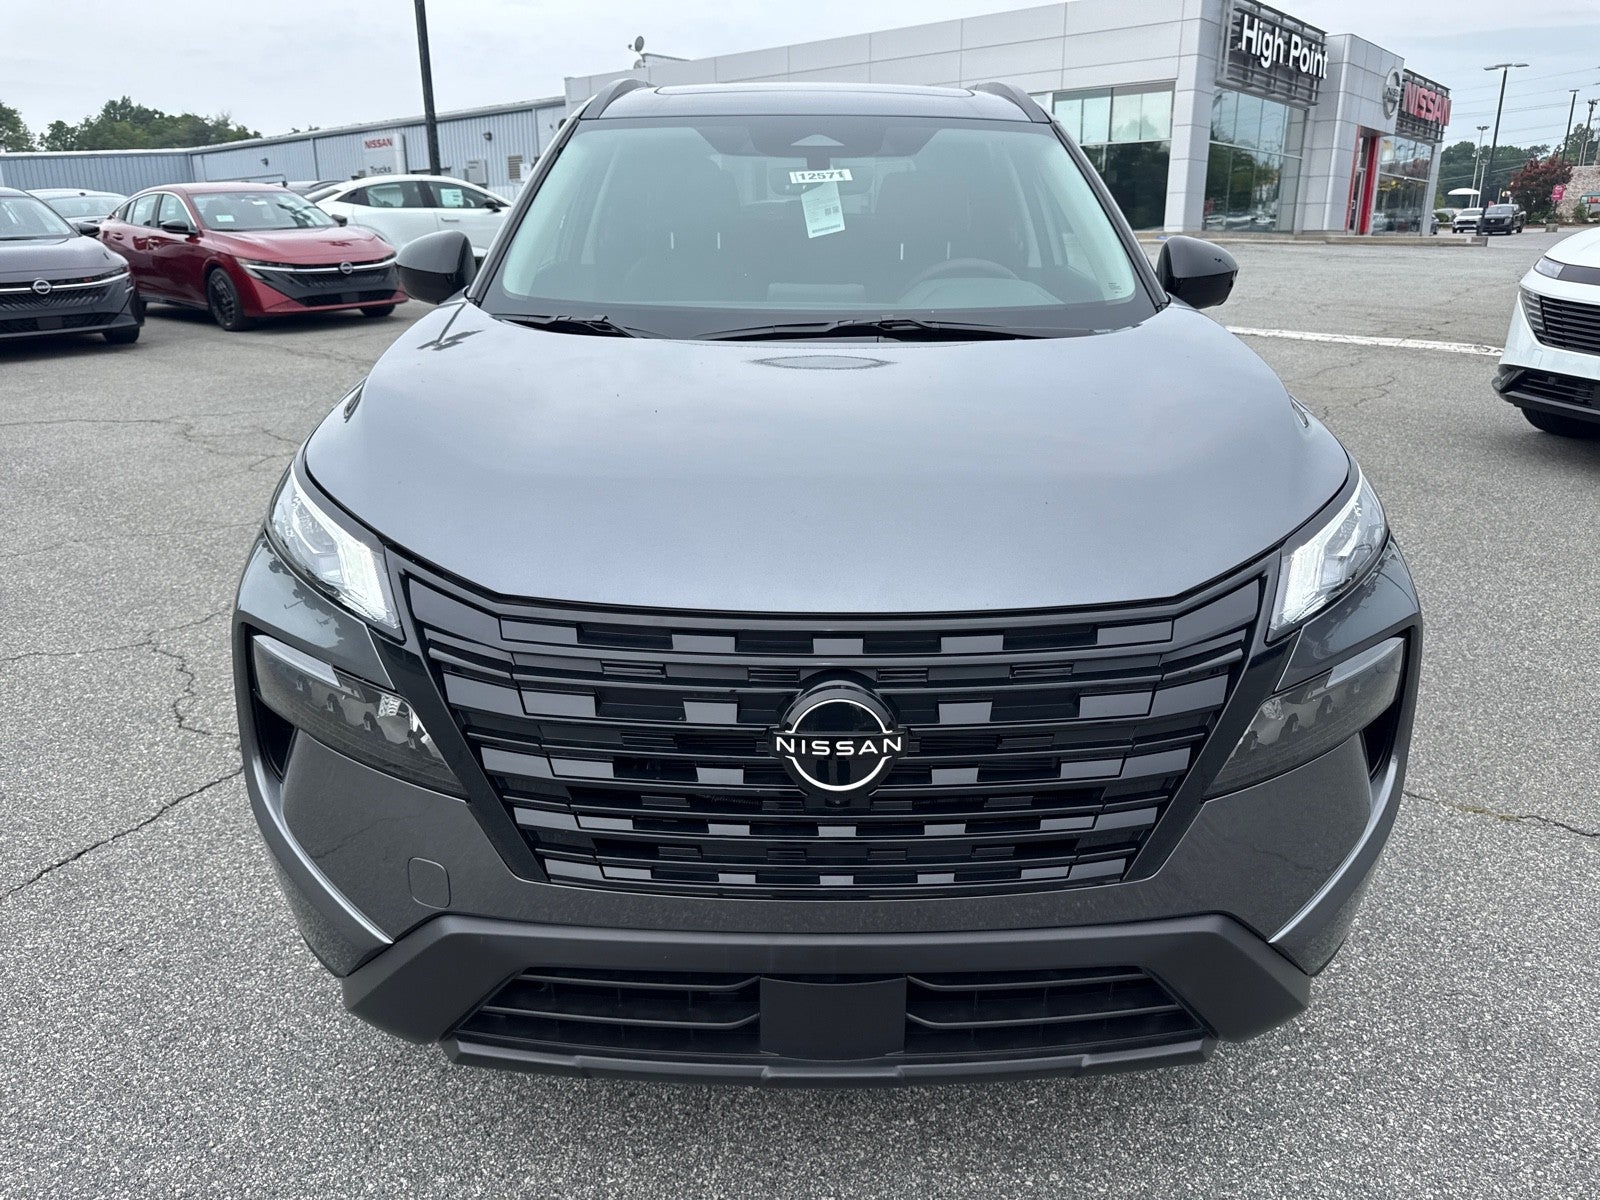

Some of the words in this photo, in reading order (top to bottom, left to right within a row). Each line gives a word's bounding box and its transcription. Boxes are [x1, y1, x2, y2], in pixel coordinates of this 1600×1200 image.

[1242, 14, 1284, 68] High
[1289, 34, 1328, 79] Point
[1402, 81, 1452, 126] NISSAN
[364, 138, 392, 149] NISSAN
[799, 171, 845, 180] 12571
[776, 736, 901, 756] NISSAN
